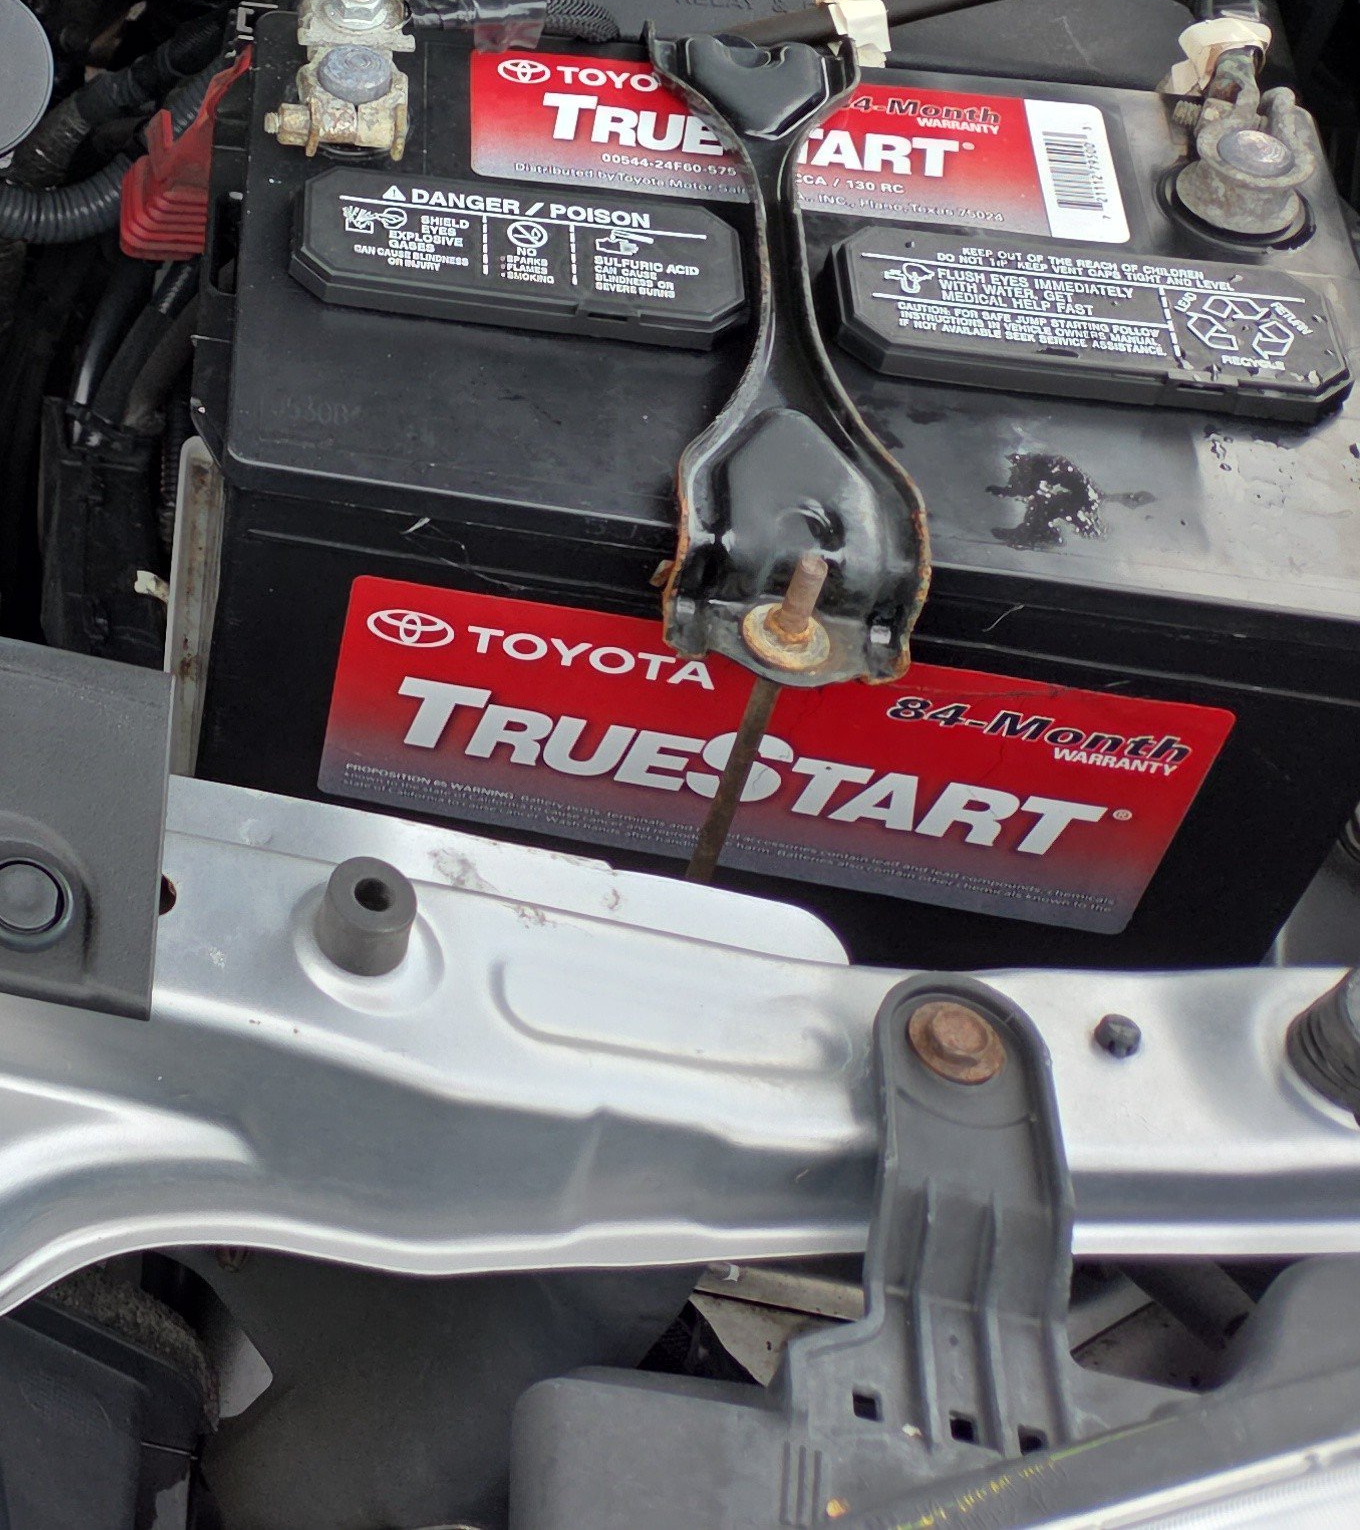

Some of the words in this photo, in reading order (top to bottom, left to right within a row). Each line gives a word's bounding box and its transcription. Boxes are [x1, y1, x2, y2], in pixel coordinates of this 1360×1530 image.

[556, 66, 661, 92] TOYO
[843, 95, 1000, 123] 4-Month
[917, 117, 1000, 135] WARRANTY
[618, 172, 664, 188] Toyota
[670, 178, 712, 192] Motor
[846, 179, 875, 191] 130
[881, 183, 905, 194] RC
[412, 189, 519, 215] DANGER
[525, 203, 544, 216] /
[550, 204, 650, 228] POISON
[421, 215, 469, 229] SHIELD
[422, 225, 456, 236] EYES
[389, 230, 463, 247] EXPLOSIVE
[389, 240, 435, 252] GASES
[354, 245, 375, 255] CAN
[377, 247, 411, 259] CAUSE
[413, 252, 469, 266] BLINDNESS
[507, 255, 548, 267] SPARKS
[517, 247, 536, 257] NO
[388, 257, 403, 266] OR
[405, 260, 440, 271] INJURY
[507, 264, 548, 275] FLAMES
[594, 256, 663, 273] SULFURIC
[667, 264, 699, 276] ACID
[595, 266, 617, 276] CAN
[621, 269, 657, 280] CAUSE
[937, 253, 955, 262] DO
[959, 255, 983, 265] NOT
[1017, 262, 1048, 271] KEEP
[1052, 266, 1083, 276] VENT
[1088, 269, 1121, 280] CAPS
[1125, 273, 1161, 284] TIGHT
[1167, 277, 1191, 287] AND
[1196, 280, 1235, 291] LEVEL
[962, 248, 992, 258] KEEP
[998, 251, 1022, 261] OUT
[1027, 254, 1044, 263] OF
[1048, 256, 1072, 267] THE
[1076, 259, 1117, 271] REACH
[1121, 264, 1138, 273] OF
[1143, 266, 1204, 280] CHILDREN
[507, 272, 554, 284] SMOKING
[595, 274, 653, 289] BLINDNESS
[658, 281, 674, 291] OR
[937, 268, 985, 284] FLUSH
[990, 274, 1028, 288] EYES
[1034, 279, 1133, 299] IMMEDIATELY
[596, 282, 637, 294] SEVERE
[639, 287, 675, 299] BURNS
[938, 279, 977, 293] WITH
[1043, 290, 1073, 303] GET
[941, 290, 1007, 307] MEDICAL
[1012, 298, 1050, 311] HELP
[1057, 303, 1093, 316] FAST
[1174, 291, 1197, 312] LEAD
[900, 311, 984, 328] INSTRUCTIONS
[988, 320, 1001, 329] IN
[1003, 323, 1052, 335] VEHICLE
[954, 308, 978, 319] FOR
[982, 311, 1011, 322] SAFE
[1016, 315, 1047, 326] JUMP
[1051, 318, 1109, 333] STARTING
[1112, 325, 1160, 338] FOLLOW
[1270, 301, 1313, 335] RETURN
[899, 318, 909, 326] IF
[914, 321, 937, 331] NOT
[941, 325, 1002, 339] AVAILABLE
[1005, 331, 1036, 342] SEEK
[1039, 335, 1087, 348] SERVICE
[1221, 354, 1285, 370] RECYCLE
[466, 624, 716, 691] TOYOTA
[887, 695, 1194, 765] 84-Month
[1053, 745, 1179, 777] WARRANTY
[346, 762, 430, 785] PROPOSITION
